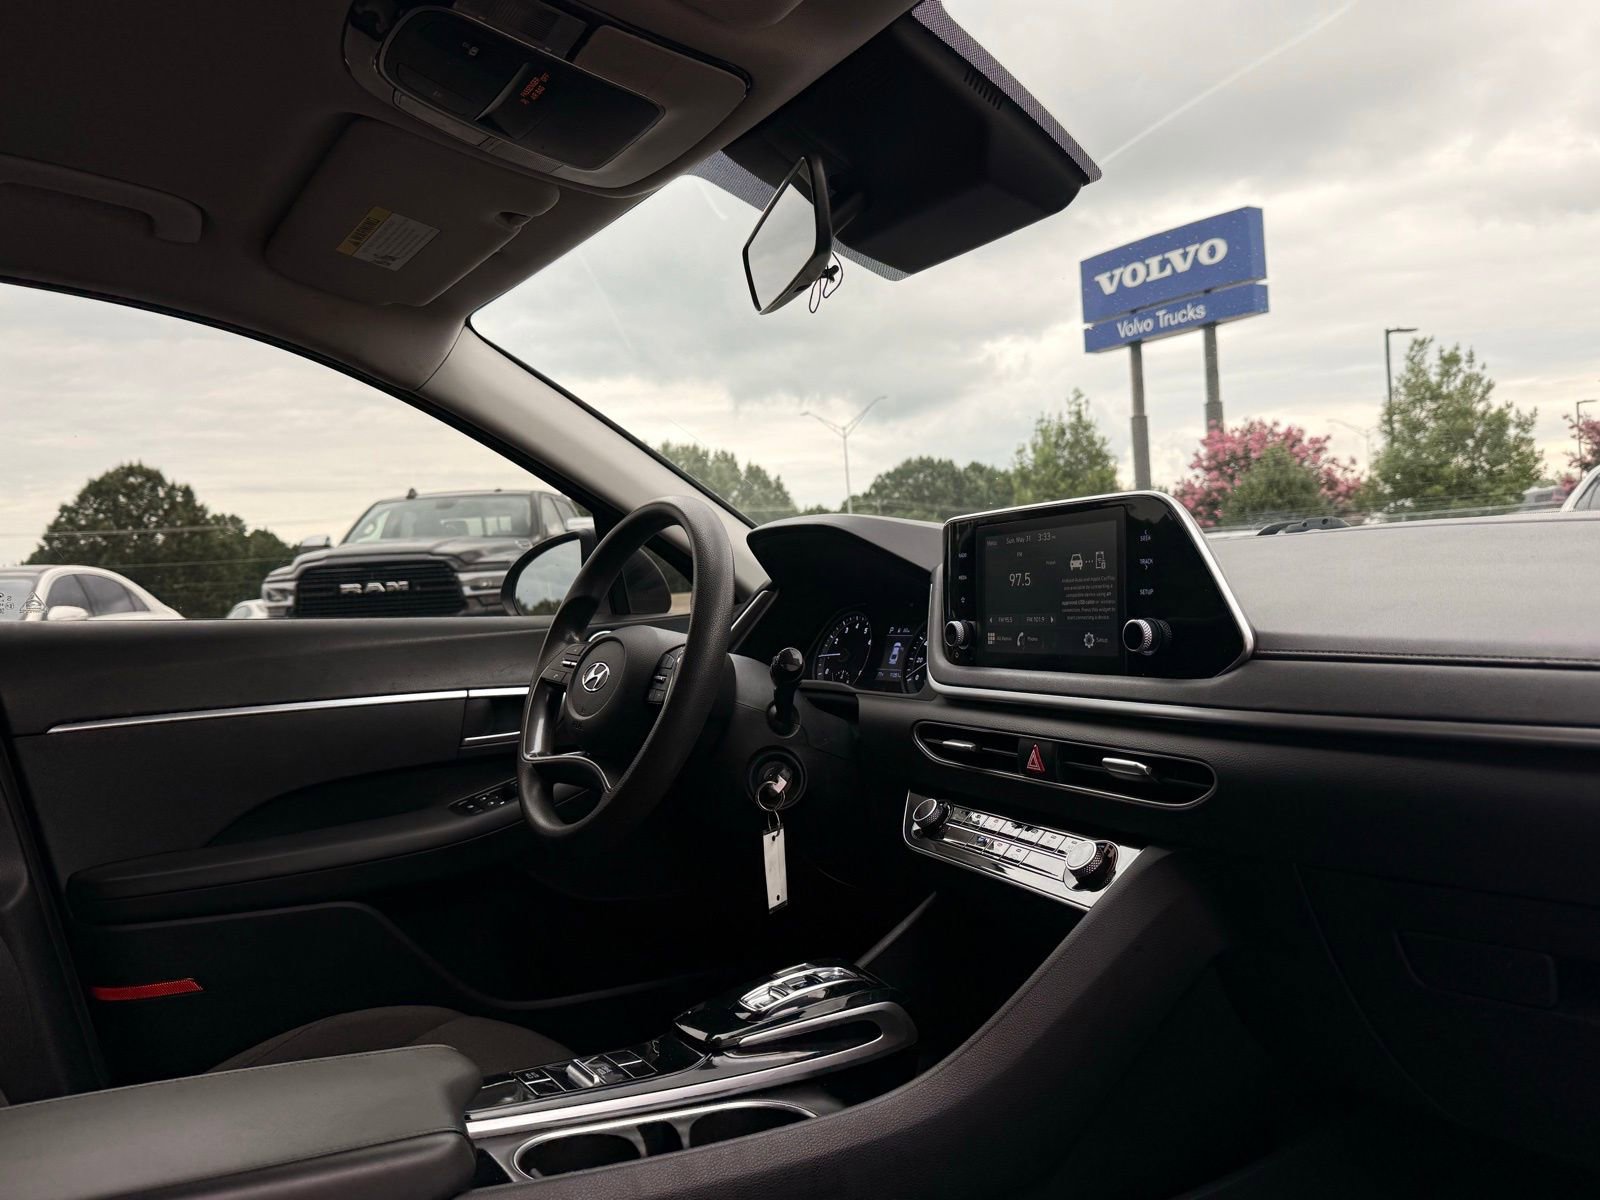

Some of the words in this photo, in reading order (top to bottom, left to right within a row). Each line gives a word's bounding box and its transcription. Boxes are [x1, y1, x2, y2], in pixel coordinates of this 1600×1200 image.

[1094, 237, 1229, 296] VOLVO
[1117, 316, 1153, 339] Volvo
[1156, 303, 1207, 329] Trucks
[1037, 532, 1051, 541] 3:33
[339, 580, 409, 594] RAM
[1009, 572, 1031, 587] 97.5
